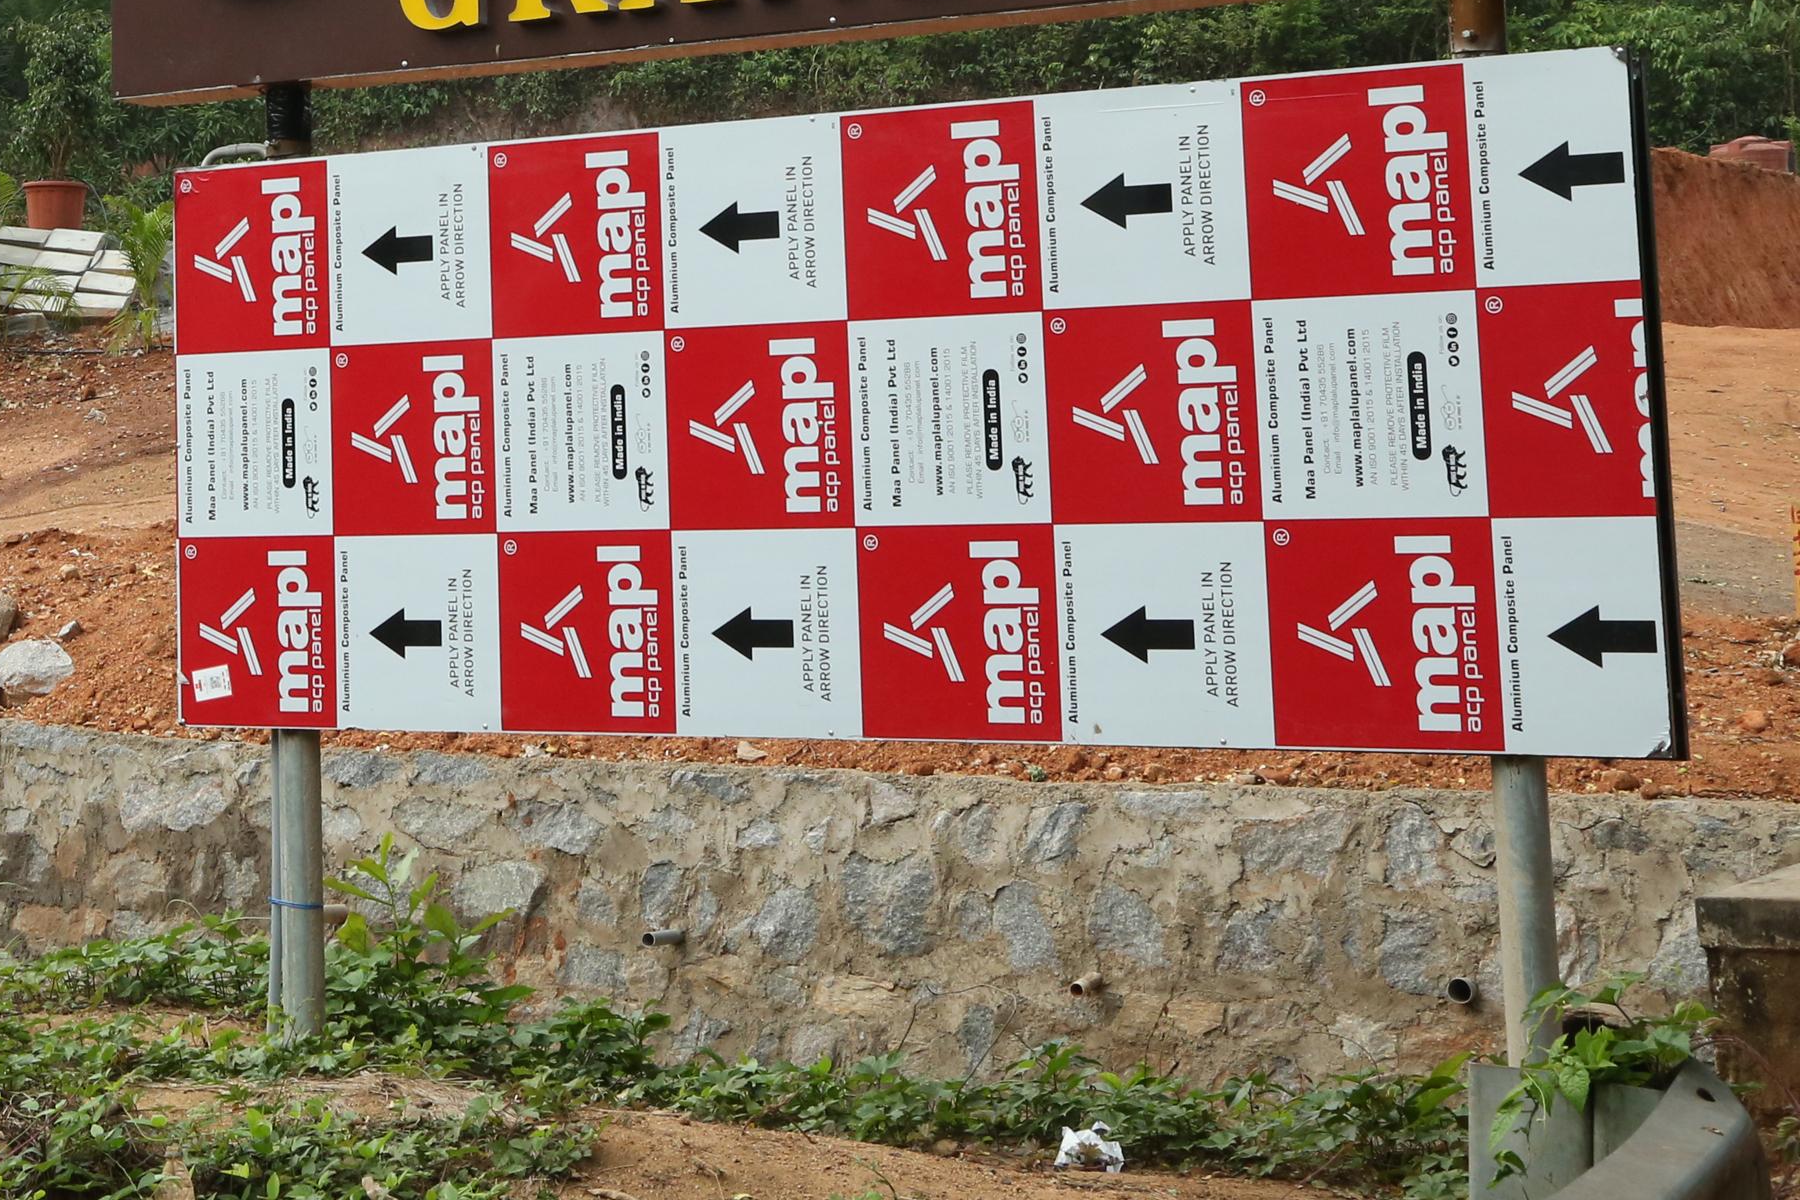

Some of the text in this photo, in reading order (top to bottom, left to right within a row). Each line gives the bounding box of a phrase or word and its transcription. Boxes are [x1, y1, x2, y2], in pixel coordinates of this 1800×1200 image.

[438, 193, 450, 300] APPLY PANEL IN
[452, 183, 465, 308] ARROW DIRECTION
[584, 149, 646, 318] mapl
[664, 147, 679, 313] Aluminium Composite Panel
[785, 166, 800, 280] APPLY PANEL IN
[801, 155, 817, 288] ARROW DIRECTION
[950, 119, 1020, 298] mapl
[1003, 181, 1027, 296] acp panel
[1041, 116, 1059, 293] Aluminium Composite Panel
[1178, 135, 1196, 257] APPLY PANEL IN
[1196, 124, 1215, 265] ARROW DIRECTION
[1367, 84, 1448, 276] mapl
[1429, 151, 1457, 273] acp panel
[1472, 80, 1495, 270] Aluminium Composite Panel
[260, 176, 315, 336] mapl
[301, 232, 318, 334] acp panel
[332, 174, 343, 331] Aluminium Composite Panel
[631, 208, 651, 316] acp panel
[422, 354, 480, 519] mapl
[466, 412, 485, 519] acp panel
[768, 337, 834, 513] mapl
[819, 399, 841, 512] acp panel
[856, 336, 872, 511] Aluminium Composite Panel
[885, 339, 901, 507] Maa Panel (India) Pvt Ltd
[985, 379, 999, 460] Made in India
[1161, 318, 1237, 505] mapl
[1220, 384, 1246, 504] acp panel
[1261, 317, 1282, 503] Aluminium Composite Panel
[1295, 319, 1316, 499] Maa Panel (India) Pvt Ltd
[1345, 328, 1364, 487] www.maplalupanel.com
[1411, 362, 1427, 448] Made in India
[267, 550, 322, 712] mapl
[308, 608, 325, 712] acp panel
[339, 550, 351, 712] Aluminium Composite Panel
[447, 577, 459, 688] APPLY PANEL IN
[461, 568, 474, 697] ARROW DIRECTION
[596, 545, 658, 717] mapl
[642, 607, 662, 717] acp panel
[677, 545, 691, 717] Aluminium Composite Panel
[799, 575, 814, 692] APPLY PANEL IN
[815, 565, 831, 702] ARROW DIRECTION
[968, 540, 1039, 724] mapl
[1022, 606, 1046, 724] acp panel
[1061, 541, 1078, 723] Aluminium Composite Panel
[1200, 571, 1219, 697] APPLY PANEL IN
[1219, 561, 1239, 707] ARROW DIRECTION
[1393, 535, 1476, 732] mapl
[1456, 605, 1485, 732] acp panel
[1500, 535, 1523, 732] Aluminium Composite Panel
